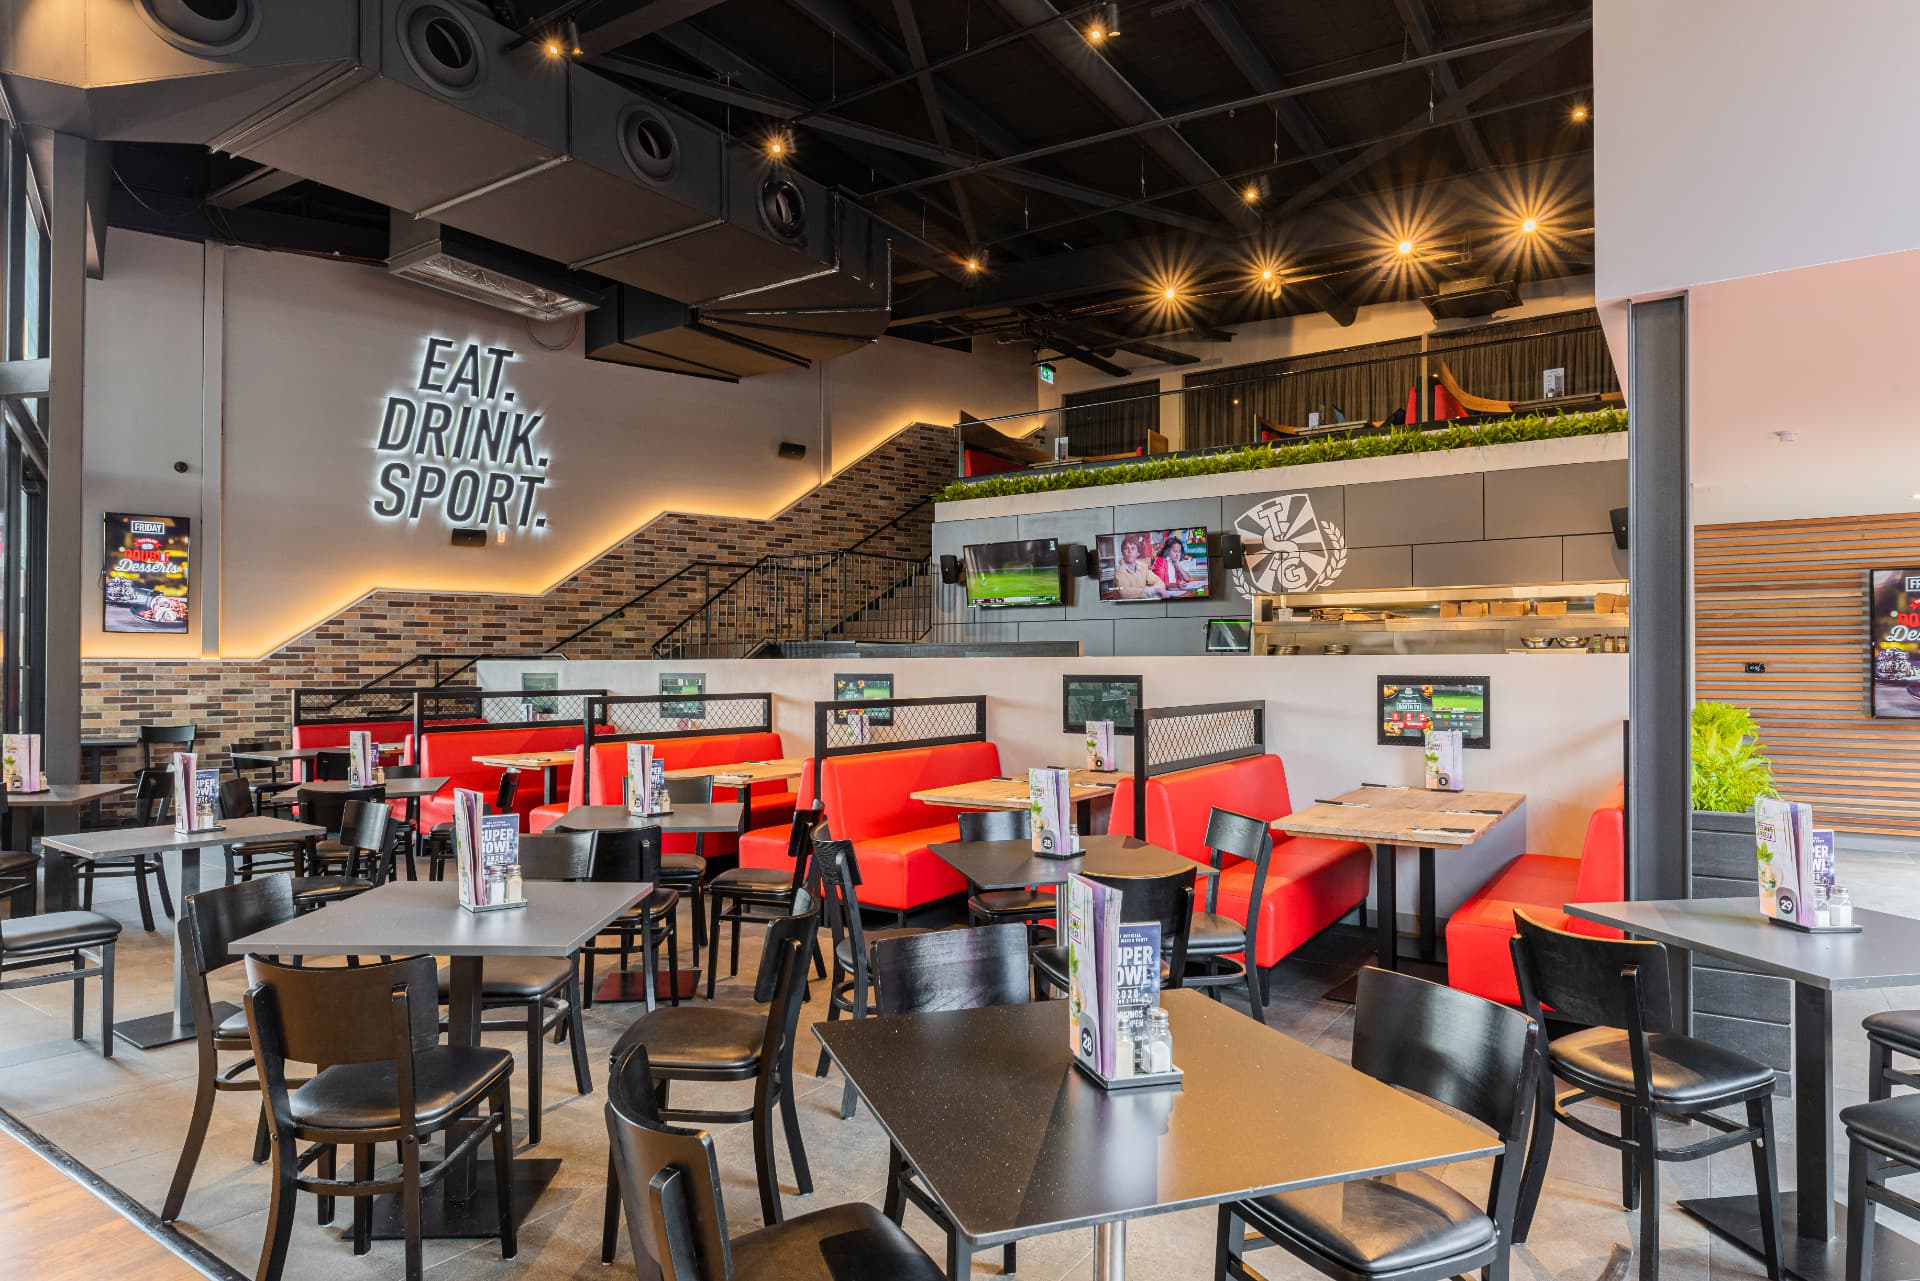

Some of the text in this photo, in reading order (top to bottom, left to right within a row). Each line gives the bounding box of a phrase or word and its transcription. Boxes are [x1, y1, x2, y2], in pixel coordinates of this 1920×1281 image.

[419, 338, 515, 402] EAT.
[377, 396, 549, 468] DRINK.
[373, 462, 548, 528] SPORT.
[134, 522, 162, 533] FRIDAY
[124, 549, 171, 563] DOUBLE
[115, 558, 180, 574] Desserts
[196, 786, 215, 796] OWL
[1043, 839, 1053, 847] 25
[1780, 899, 1792, 911] 29
[1117, 966, 1151, 985] OWL
[1083, 1033, 1092, 1053] 28
